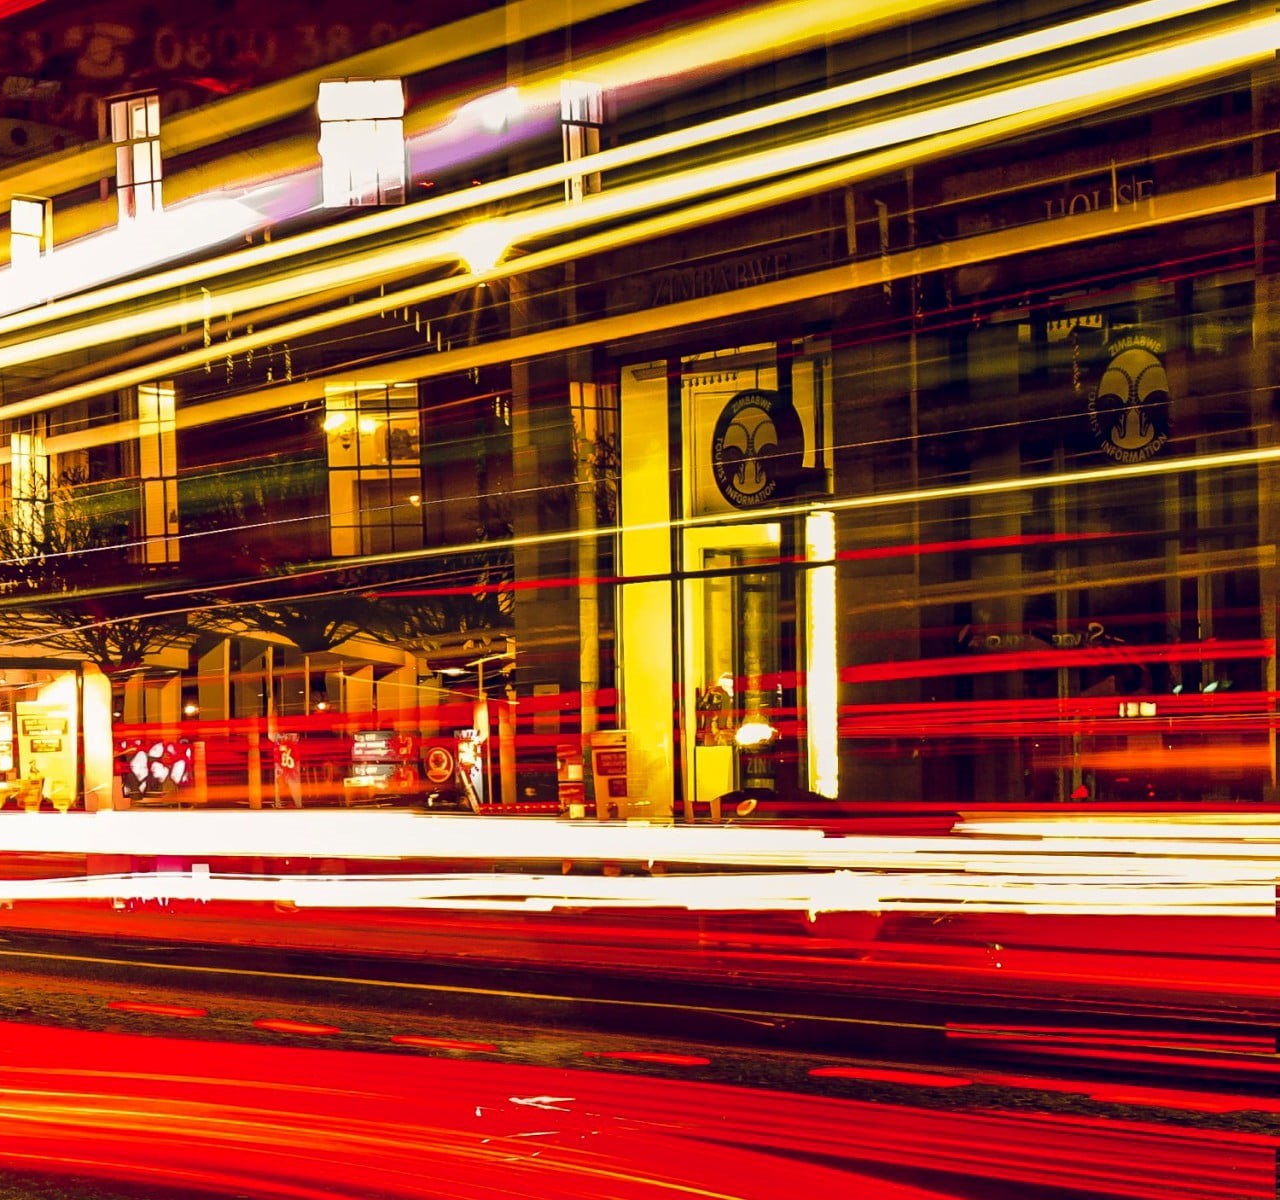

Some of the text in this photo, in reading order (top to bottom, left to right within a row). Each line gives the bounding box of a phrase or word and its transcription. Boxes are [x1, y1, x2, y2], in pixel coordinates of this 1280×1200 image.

[1108, 335, 1162, 356] ZIMBABWE
[731, 395, 772, 414] ZIMBABWE
[1101, 432, 1168, 463] INFORMATION
[725, 481, 776, 505] INFORMATION
